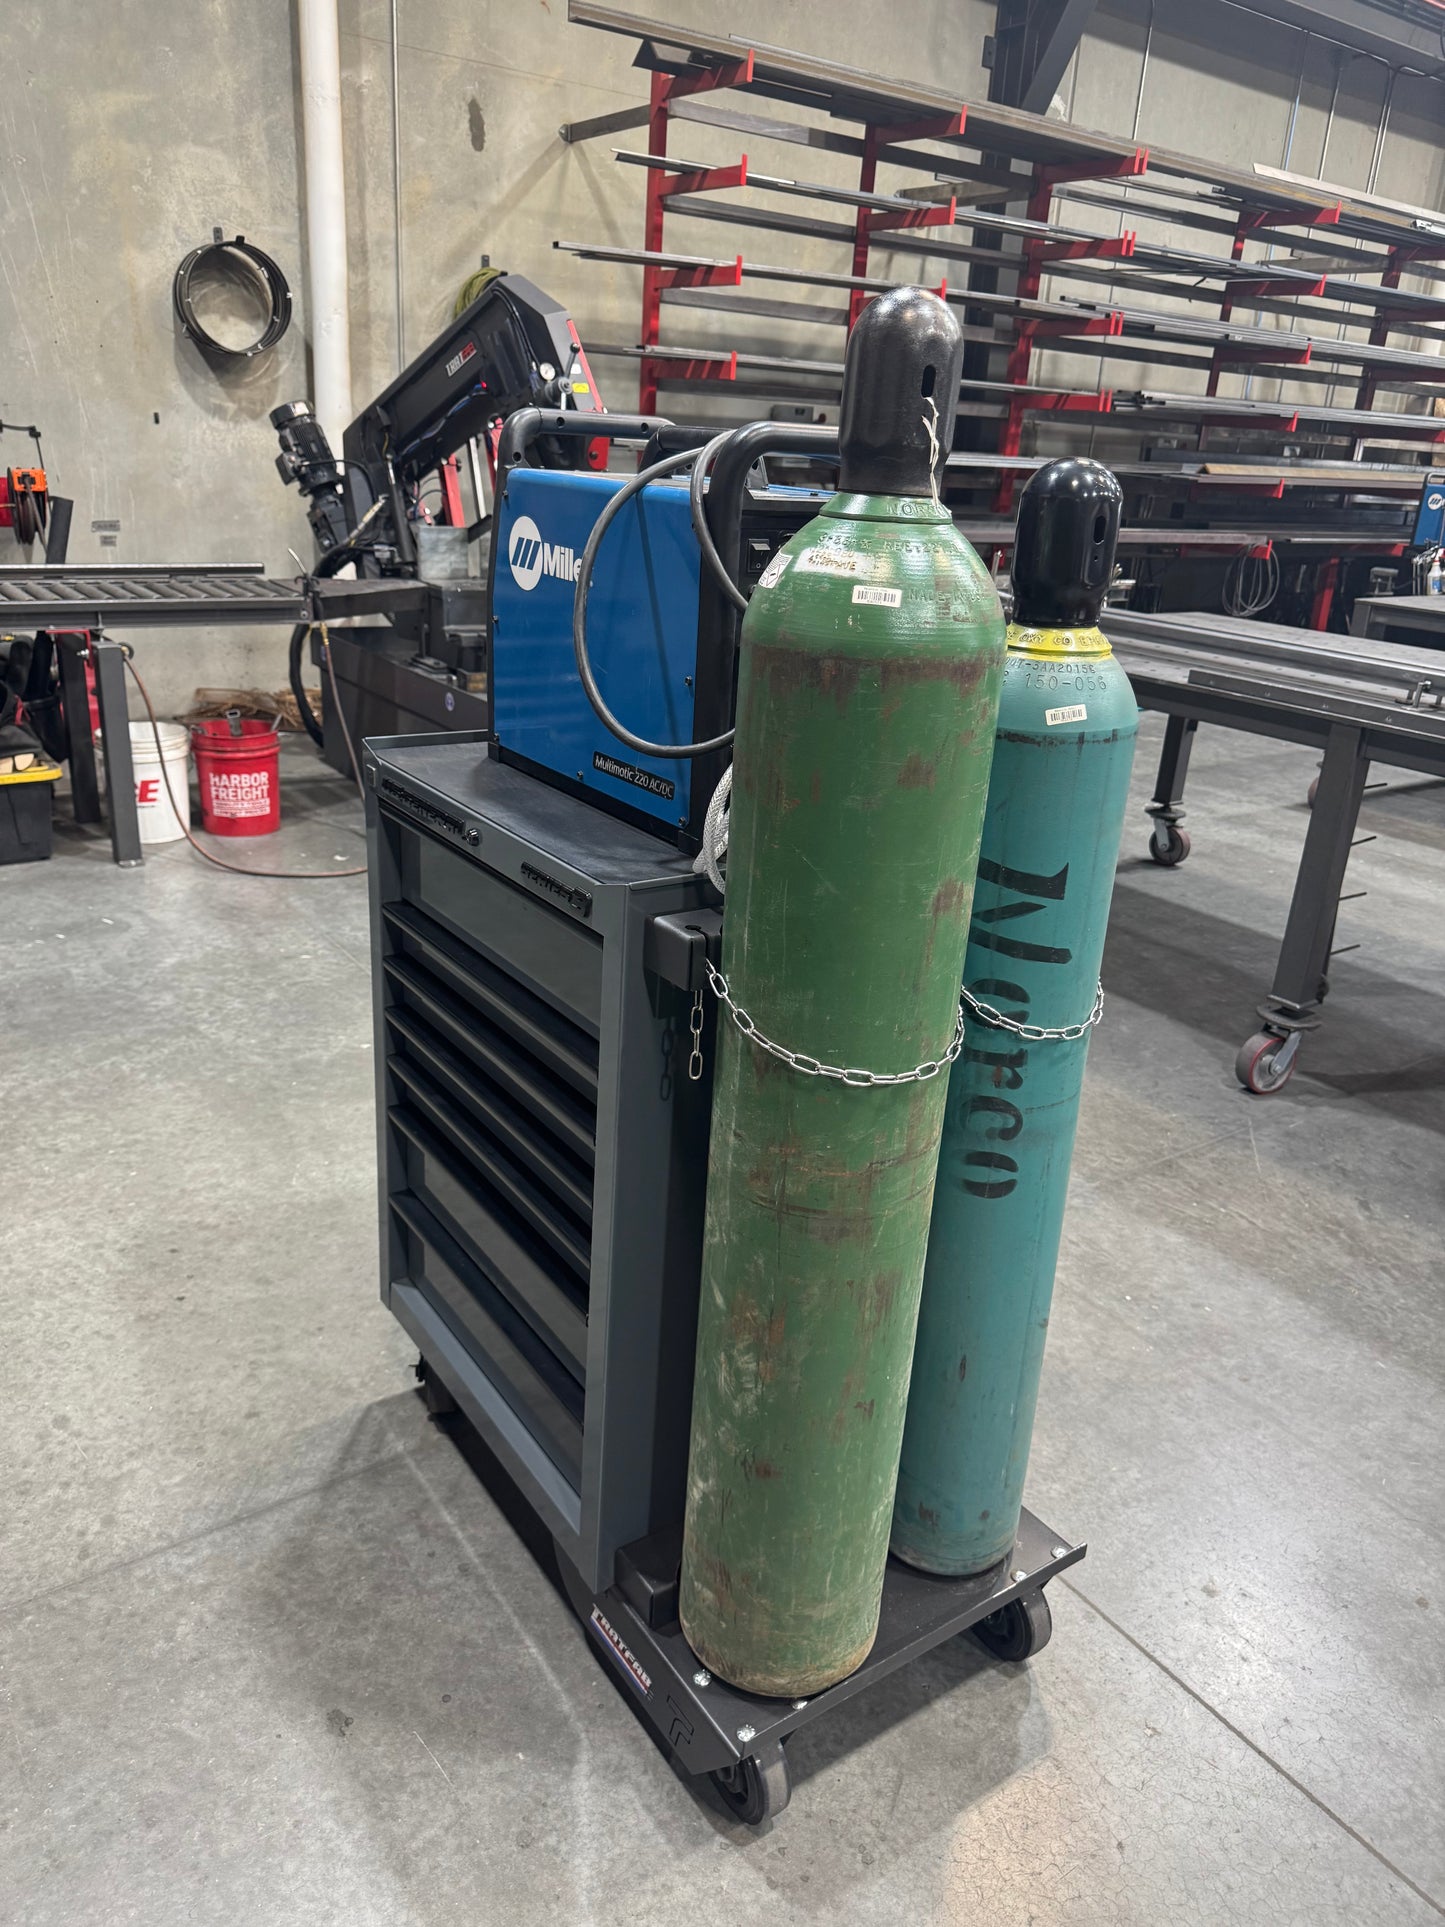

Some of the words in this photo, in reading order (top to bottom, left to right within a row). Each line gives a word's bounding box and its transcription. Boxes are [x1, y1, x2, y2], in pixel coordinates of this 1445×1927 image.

[209, 771, 269, 788] HARBOR
[634, 771, 649, 788] 220
[649, 780, 674, 798] AC/DC
[210, 784, 270, 801] FREIGHT
